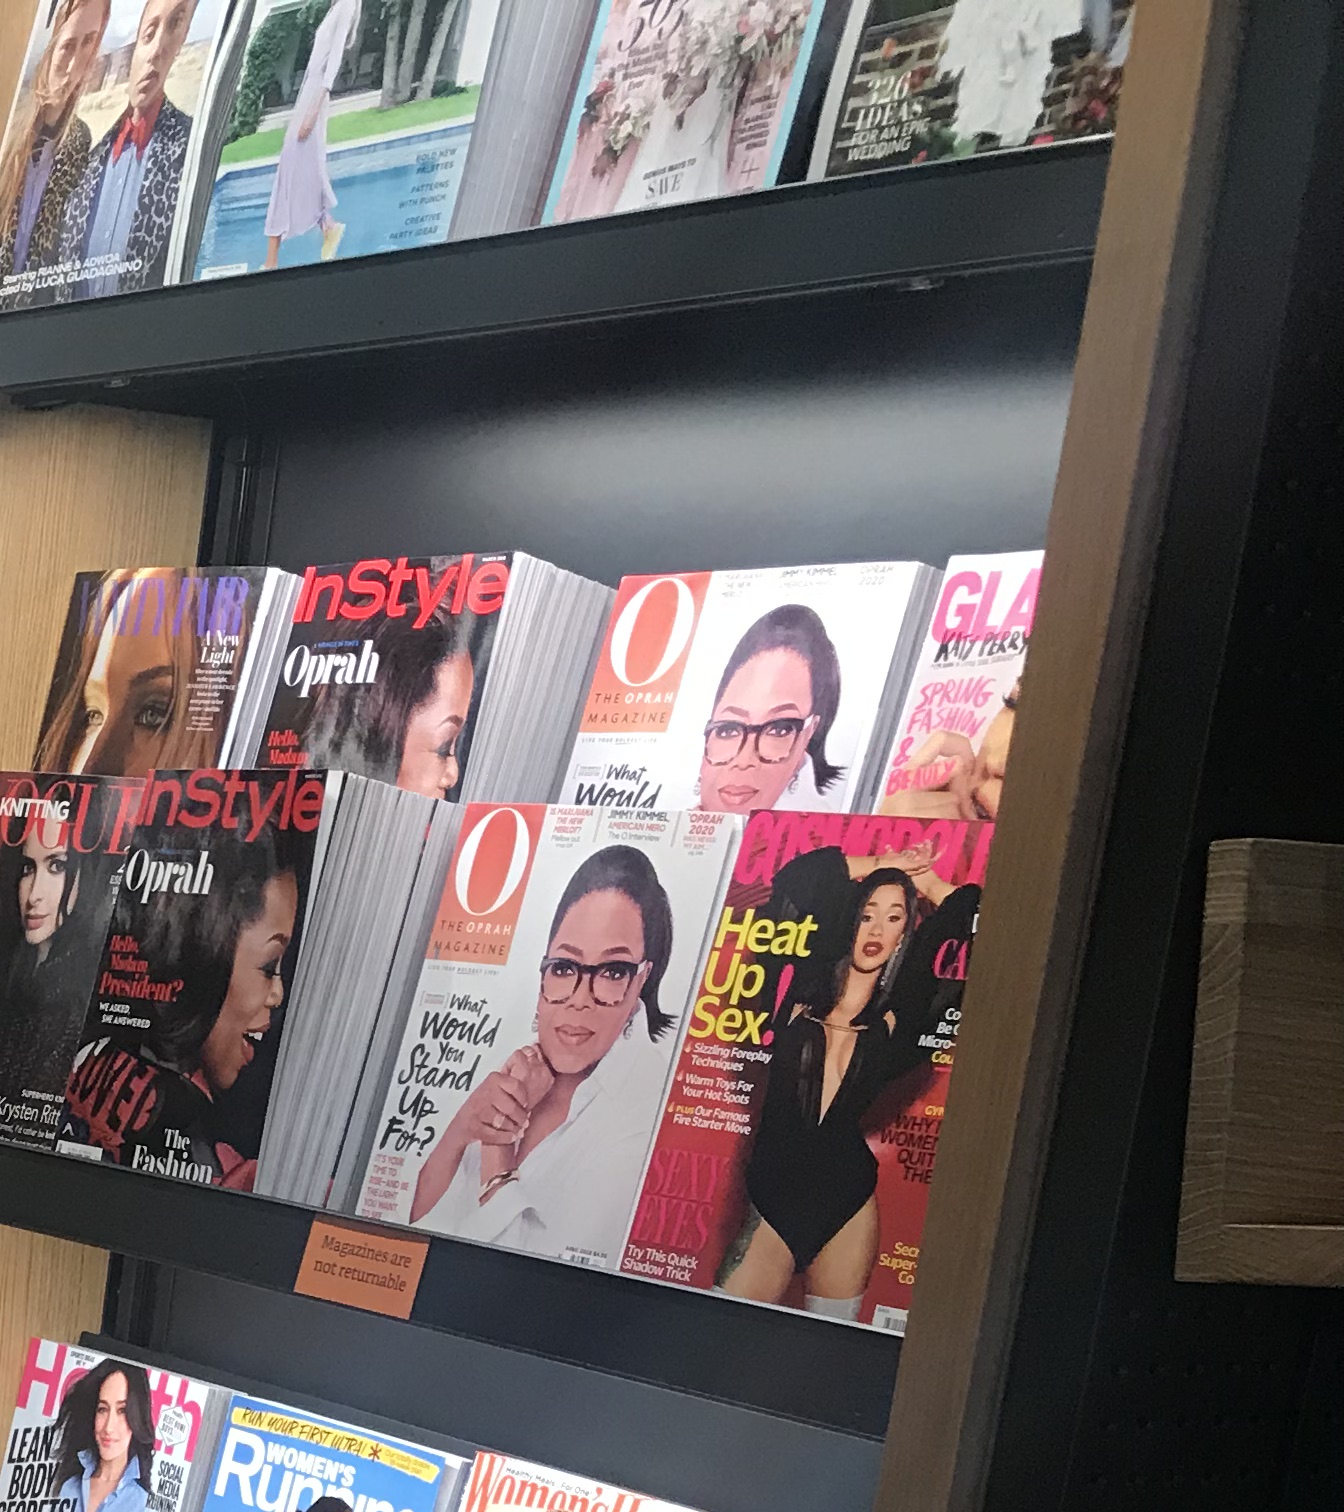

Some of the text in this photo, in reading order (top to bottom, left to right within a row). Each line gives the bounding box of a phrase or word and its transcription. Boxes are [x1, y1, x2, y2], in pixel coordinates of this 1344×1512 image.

[847, 138, 911, 161] WEDDING
[36, 272, 65, 290] LUCA
[66, 259, 142, 285] GUADAGNINO
[292, 553, 507, 628] InStyle
[610, 577, 695, 687] O
[200, 646, 235, 668] Light
[284, 639, 380, 698] Oprah
[595, 691, 674, 705] THE OPRAH
[915, 675, 997, 711] SPRING
[587, 711, 667, 725] MAGAZINE
[907, 707, 986, 739] FASHION
[606, 763, 647, 785] What
[885, 760, 957, 797] BEAUTY
[135, 768, 325, 843] InStyle
[574, 781, 662, 809] Would
[608, 811, 635, 821] JIMMY
[126, 848, 213, 905] Oprah
[455, 806, 530, 917] O
[440, 919, 512, 935] THE OPRAH
[714, 905, 819, 958] Heat
[433, 940, 507, 956] MAGAZINE
[99, 968, 184, 1002] President?
[704, 951, 766, 1006] Up
[450, 993, 488, 1016] What
[419, 1010, 501, 1046] Would
[398, 1043, 481, 1092] Stand
[438, 1041, 465, 1065] You
[691, 1055, 744, 1072] Techniques
[730, 1046, 773, 1065] Foreplay
[682, 1085, 750, 1106] Your Hot Spots
[685, 1072, 755, 1093] Warm Toys For
[398, 1089, 440, 1129] Up
[673, 1113, 752, 1136] Fire Starter Move
[379, 1116, 436, 1158] For?
[131, 1146, 213, 1184] Fashion
[321, 1234, 412, 1269] Magazines are
[627, 1243, 699, 1270] Try This Quick
[313, 1258, 407, 1292] not returnable
[623, 1257, 692, 1282] Shadow Trick
[241, 1406, 267, 1428] RUN
[267, 1413, 298, 1436] YOUR
[298, 1423, 331, 1446] FIRST
[7, 1425, 55, 1465] LEAN
[7, 1462, 60, 1501] BODY
[266, 1441, 357, 1488] WOMEN'S
